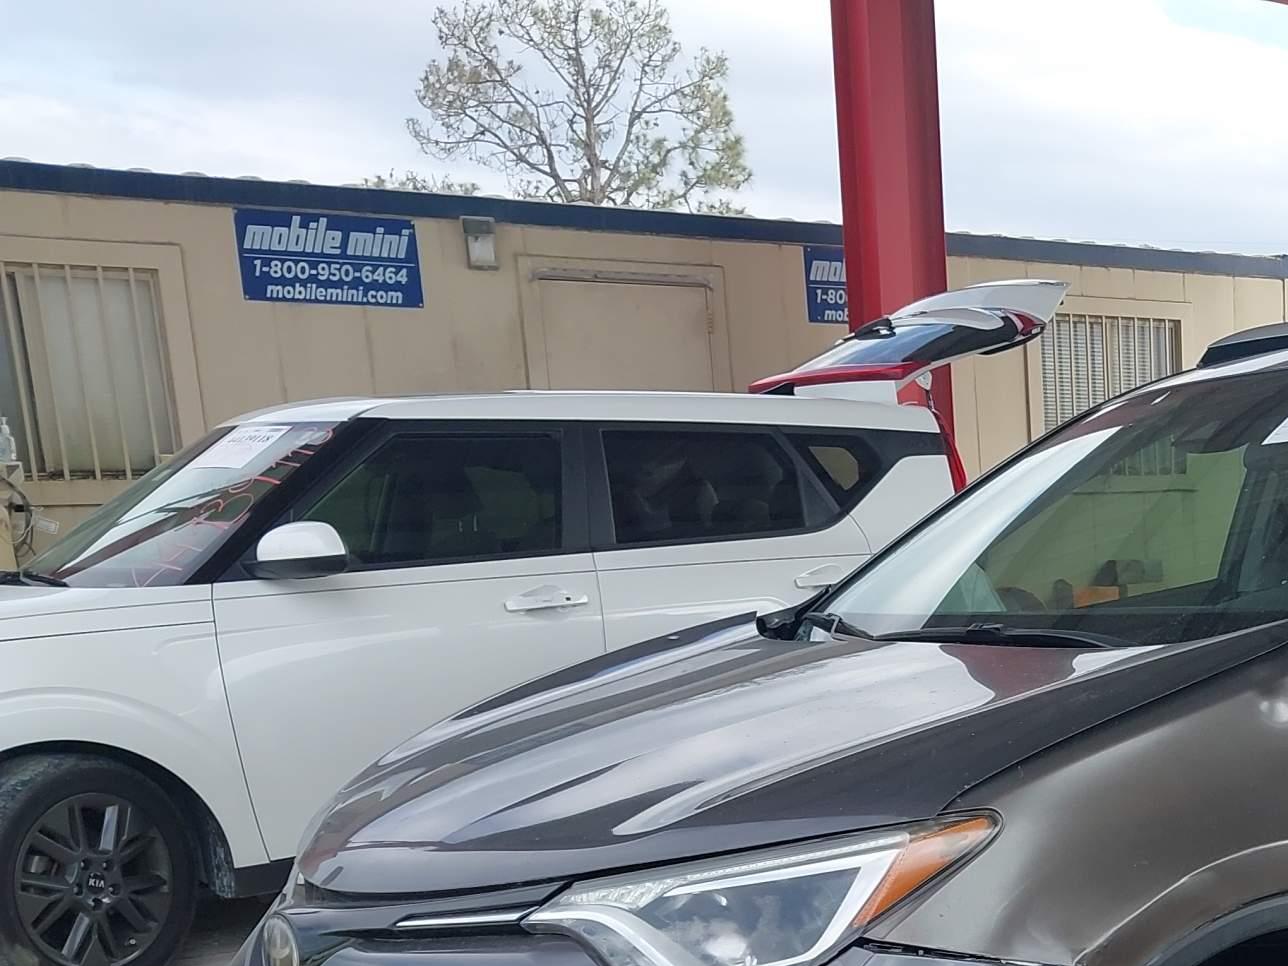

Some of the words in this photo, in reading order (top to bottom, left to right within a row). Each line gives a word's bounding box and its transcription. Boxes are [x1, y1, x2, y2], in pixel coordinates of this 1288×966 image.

[243, 215, 342, 254] mobile
[347, 227, 409, 259] mini
[253, 260, 408, 285] 1-800-950-6464
[809, 257, 846, 282] mo
[266, 282, 403, 304] mobilemini.com
[816, 289, 848, 304] 1-80
[88, 878, 105, 888] KIA
